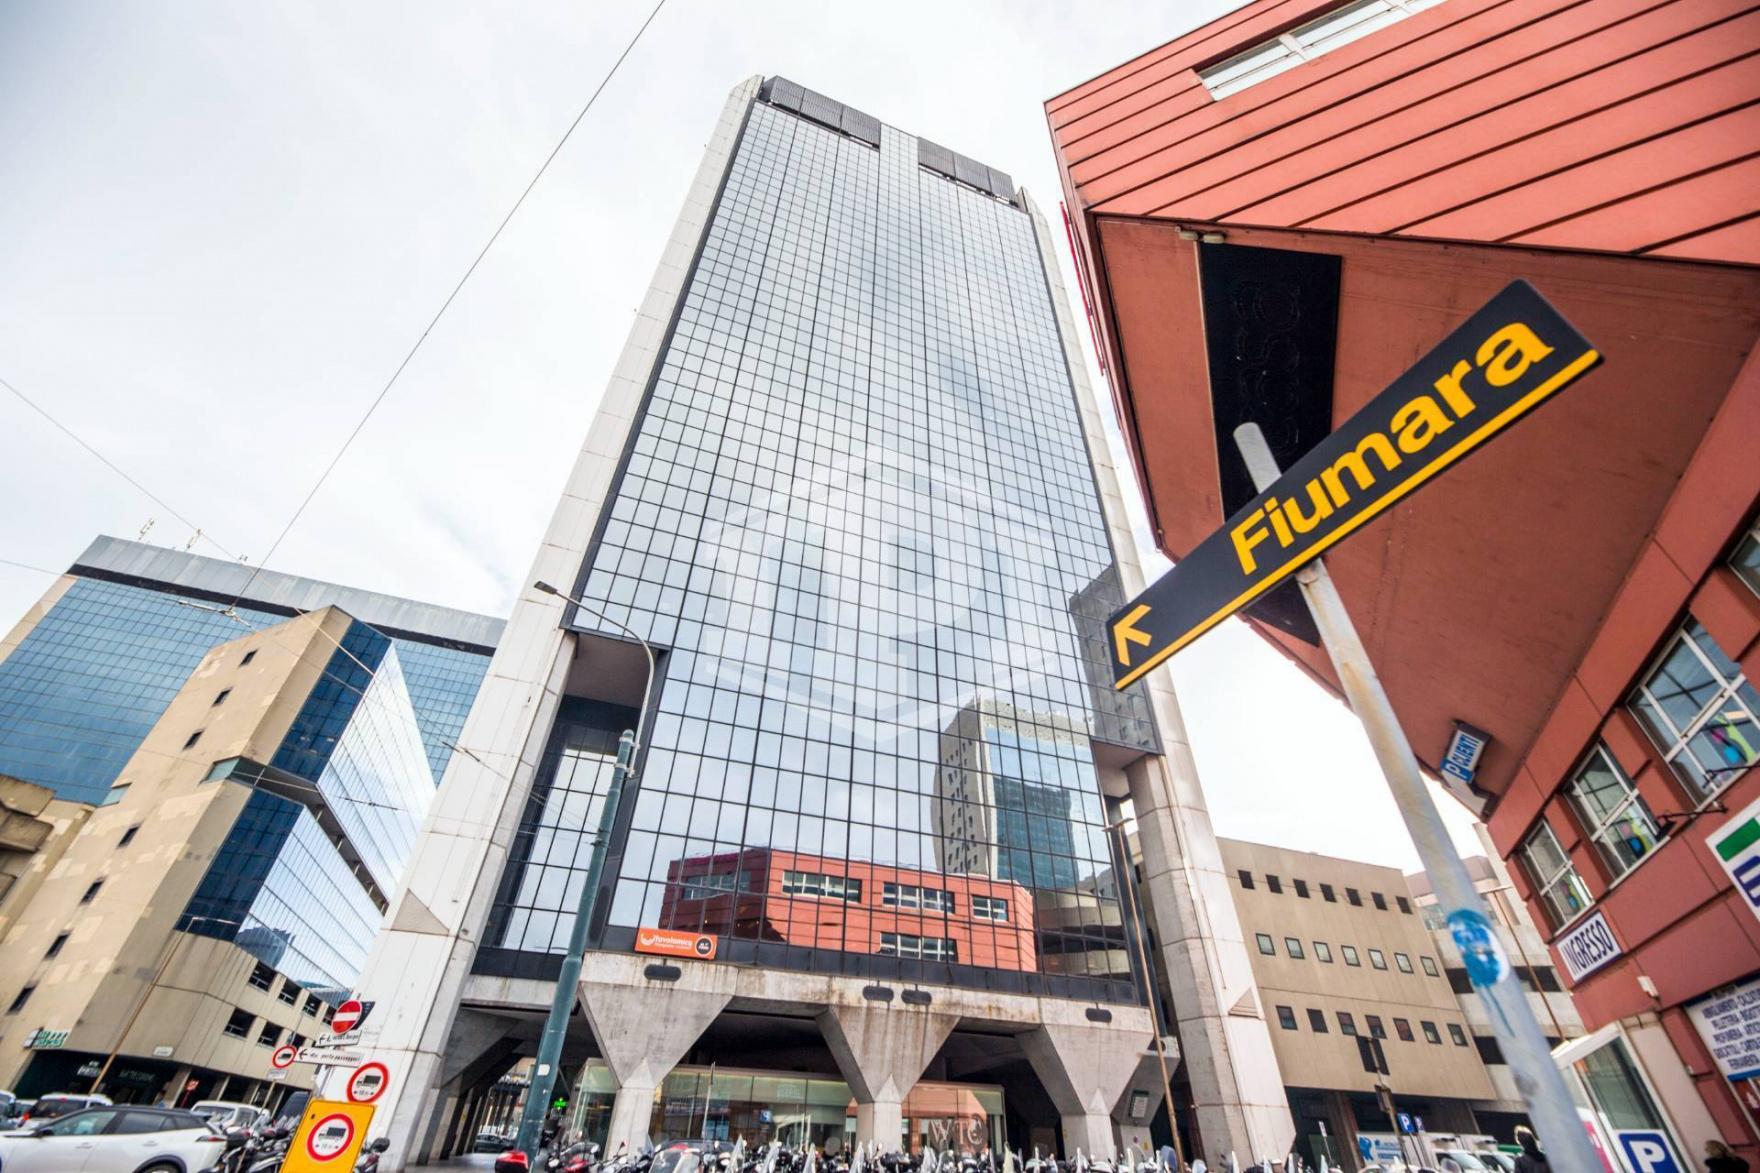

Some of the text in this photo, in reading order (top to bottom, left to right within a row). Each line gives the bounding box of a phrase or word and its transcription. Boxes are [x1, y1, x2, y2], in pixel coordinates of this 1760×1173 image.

[1230, 321, 1555, 576] Fiumara
[1445, 733, 1480, 779] P CLIENTI
[1561, 919, 1614, 976] INGRESSO
[1401, 1115, 1410, 1131] P
[1629, 1141, 1665, 1173] P
